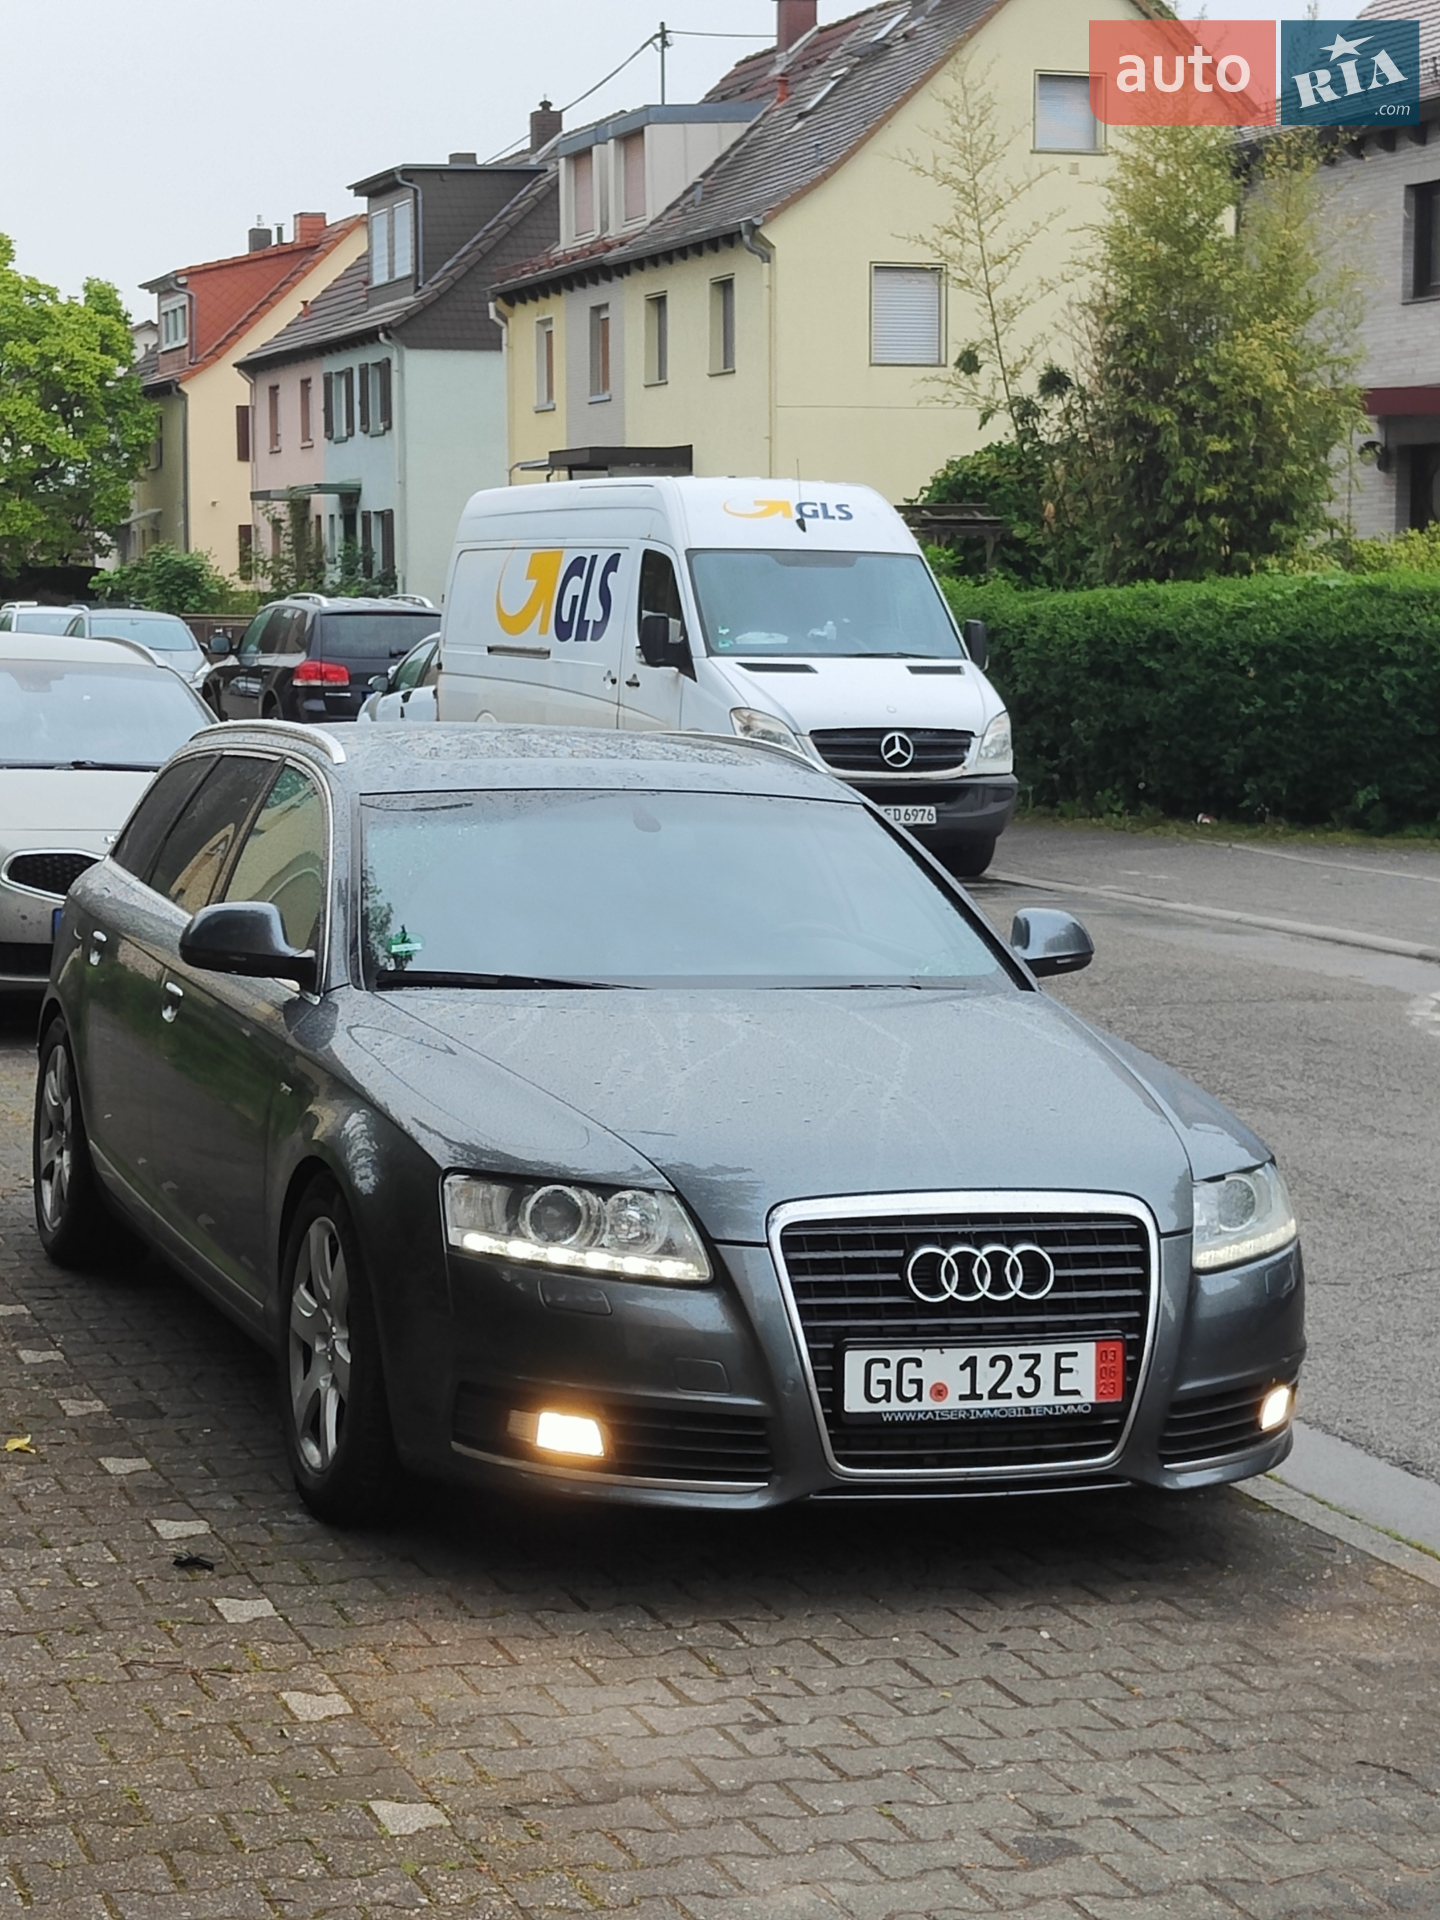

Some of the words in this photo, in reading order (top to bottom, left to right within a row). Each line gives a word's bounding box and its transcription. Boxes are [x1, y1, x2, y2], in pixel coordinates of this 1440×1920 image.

[795, 502, 853, 521] GLS
[554, 552, 621, 642] GLS
[903, 808, 934, 821] 6976
[864, 1357, 923, 1403] GG
